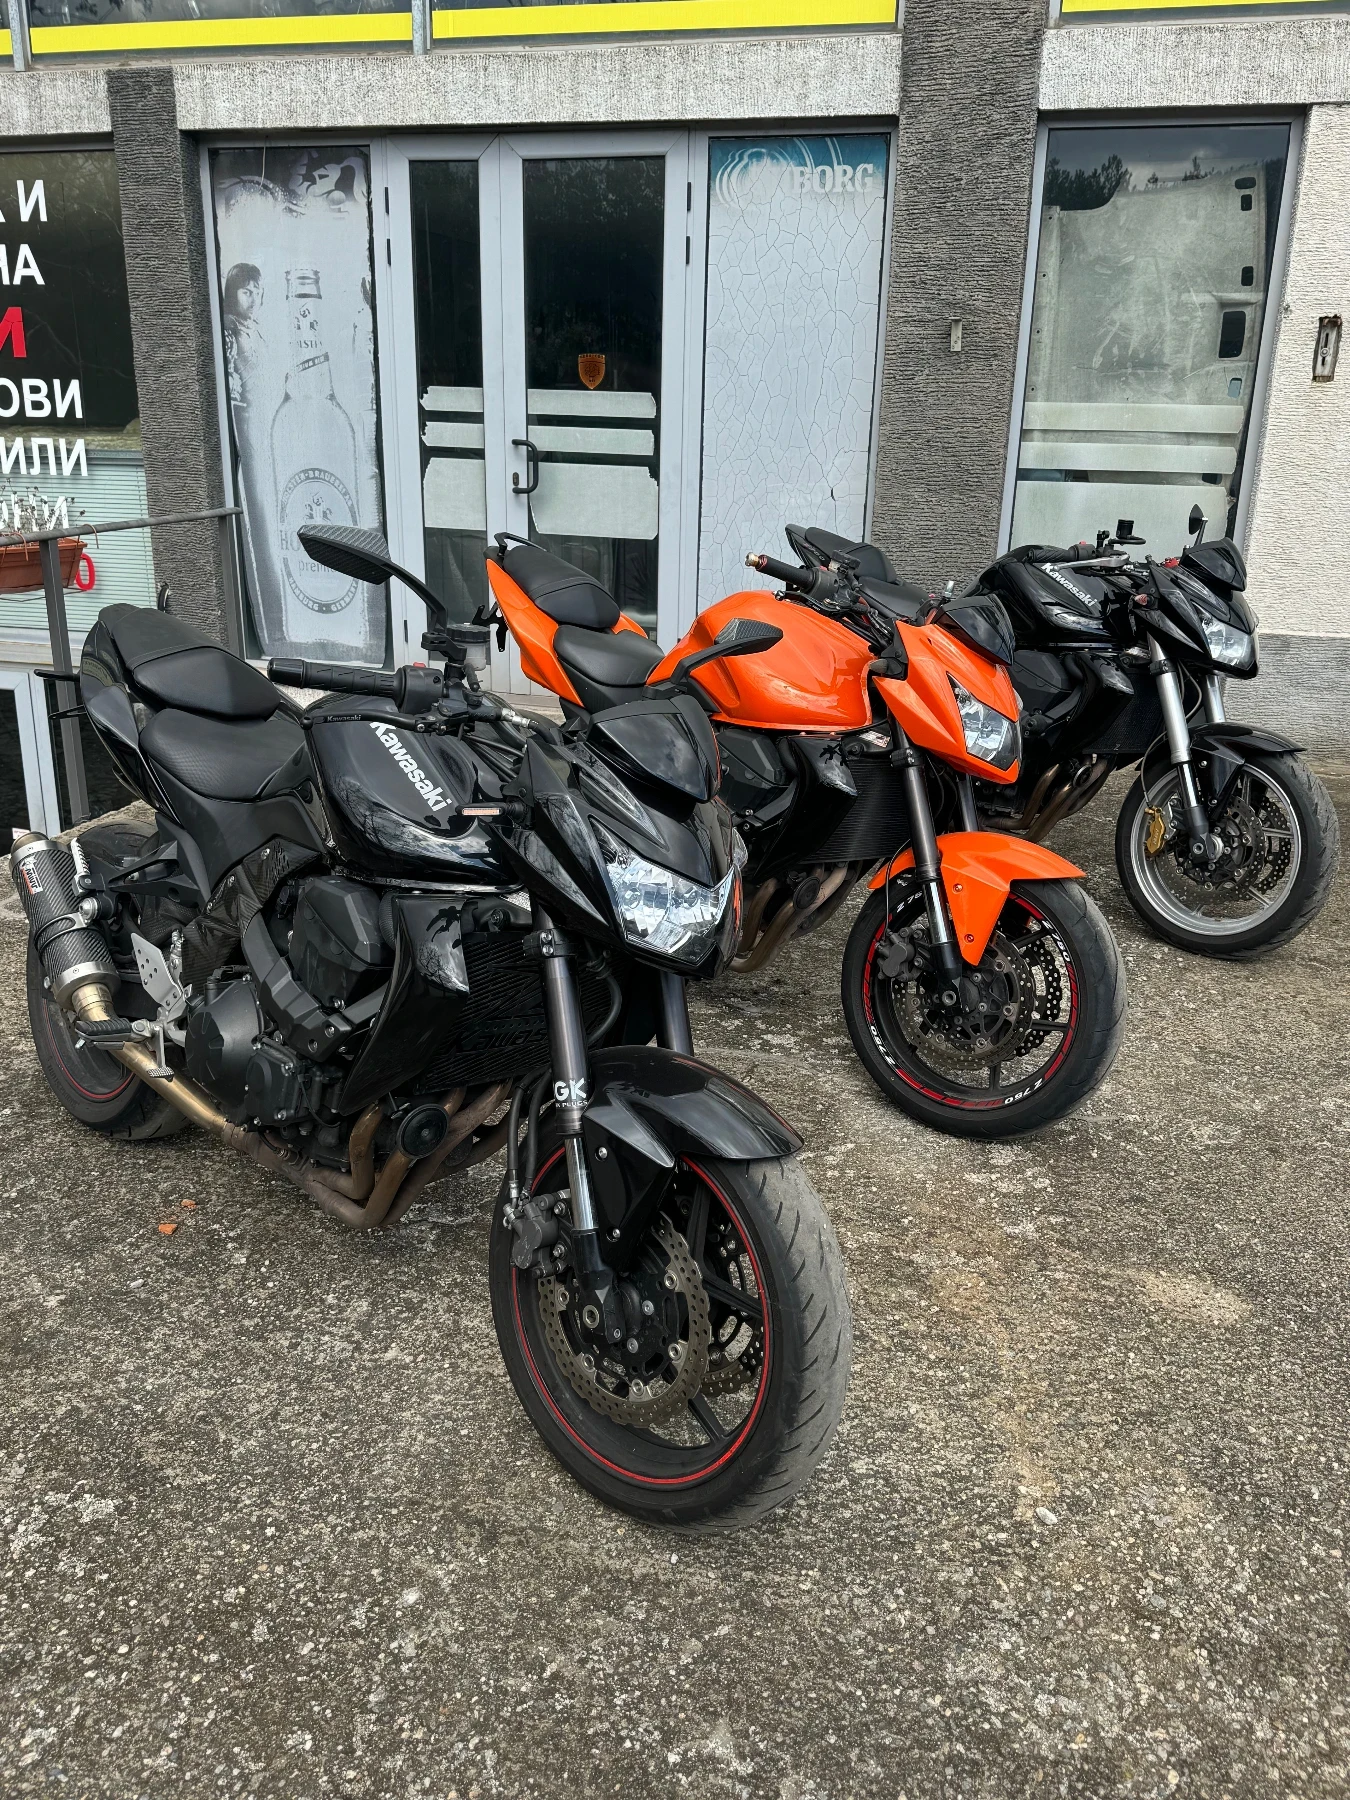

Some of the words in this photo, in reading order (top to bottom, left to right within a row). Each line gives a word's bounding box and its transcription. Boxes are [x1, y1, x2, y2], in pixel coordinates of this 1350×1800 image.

[1040, 562, 1098, 607] Kawasaki
[327, 714, 362, 722] Kawasaki
[369, 721, 452, 812] Kawasaki
